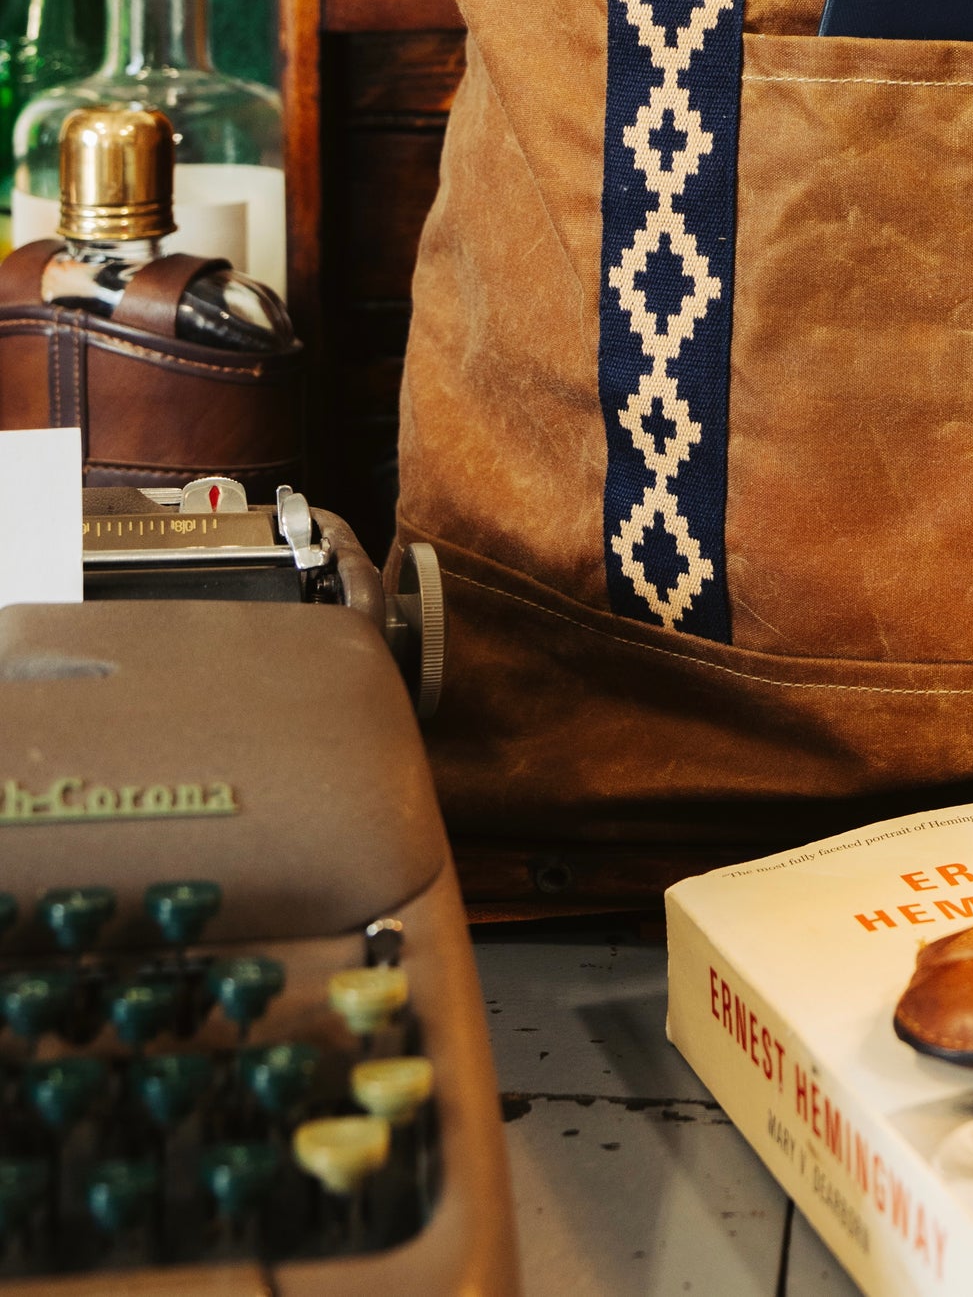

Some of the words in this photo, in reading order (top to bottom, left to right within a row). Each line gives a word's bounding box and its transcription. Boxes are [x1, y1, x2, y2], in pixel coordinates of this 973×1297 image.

[756, 862, 787, 873] most
[789, 854, 816, 866] fully
[818, 839, 862, 856] faceted
[865, 826, 912, 846] portrait
[914, 822, 926, 832] of
[709, 965, 786, 1094] ERNEST
[795, 1063, 949, 1282] HEMINGWAY
[767, 1107, 796, 1161] MARY
